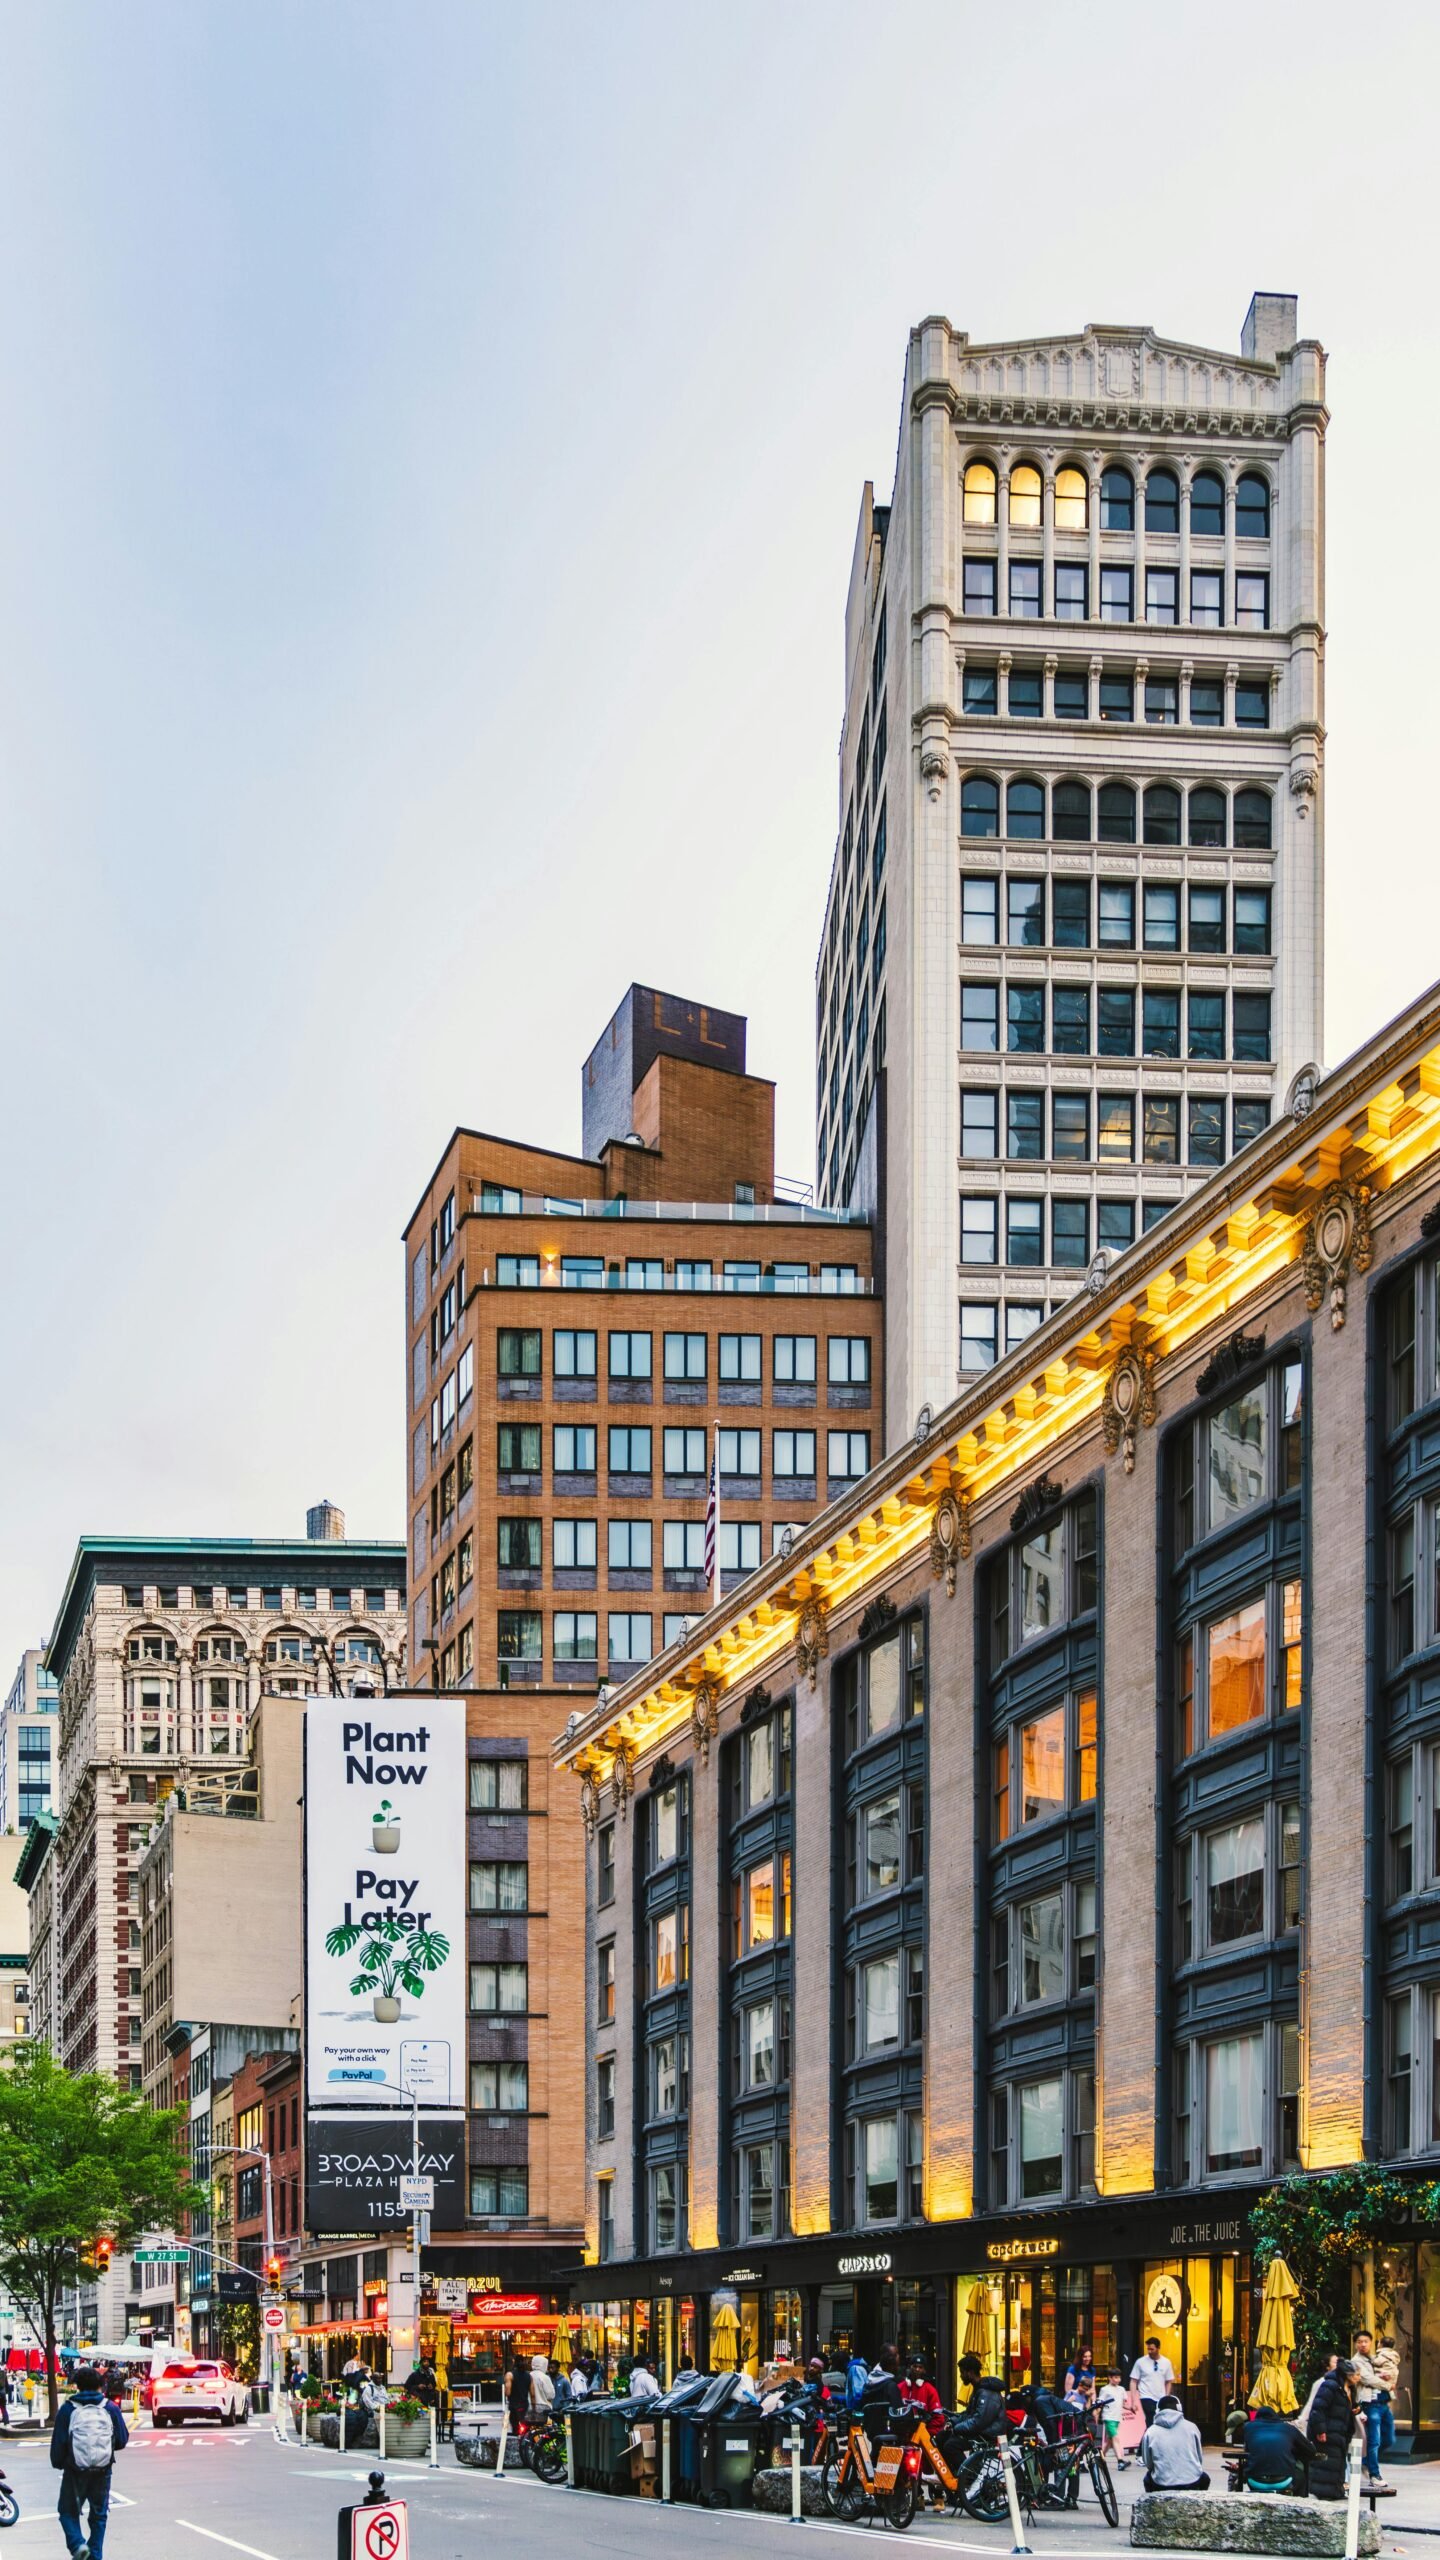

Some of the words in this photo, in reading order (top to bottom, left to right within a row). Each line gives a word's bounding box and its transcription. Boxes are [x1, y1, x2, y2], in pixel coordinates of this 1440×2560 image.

[343, 1722, 430, 1752] Plant
[346, 1756, 427, 1784] Now
[356, 1870, 419, 1908] Pay
[344, 1902, 431, 1932] Later
[324, 2046, 338, 2055] Pay
[339, 2047, 356, 2055] your
[375, 2047, 390, 2055] way
[342, 2071, 372, 2079] PayPal
[318, 2154, 455, 2172] BROADWAY
[335, 2177, 383, 2187] PLAZA
[367, 2202, 406, 2217] 1155
[1170, 2225, 1186, 2244] JOE
[1194, 2223, 1211, 2242] THE
[1213, 2220, 1240, 2241] JUICE
[147, 2252, 154, 2260] W
[157, 2252, 166, 2260] 27
[169, 2252, 176, 2260] St
[125, 2438, 252, 2448] ONLY
[929, 2448, 947, 2474] JOCO
